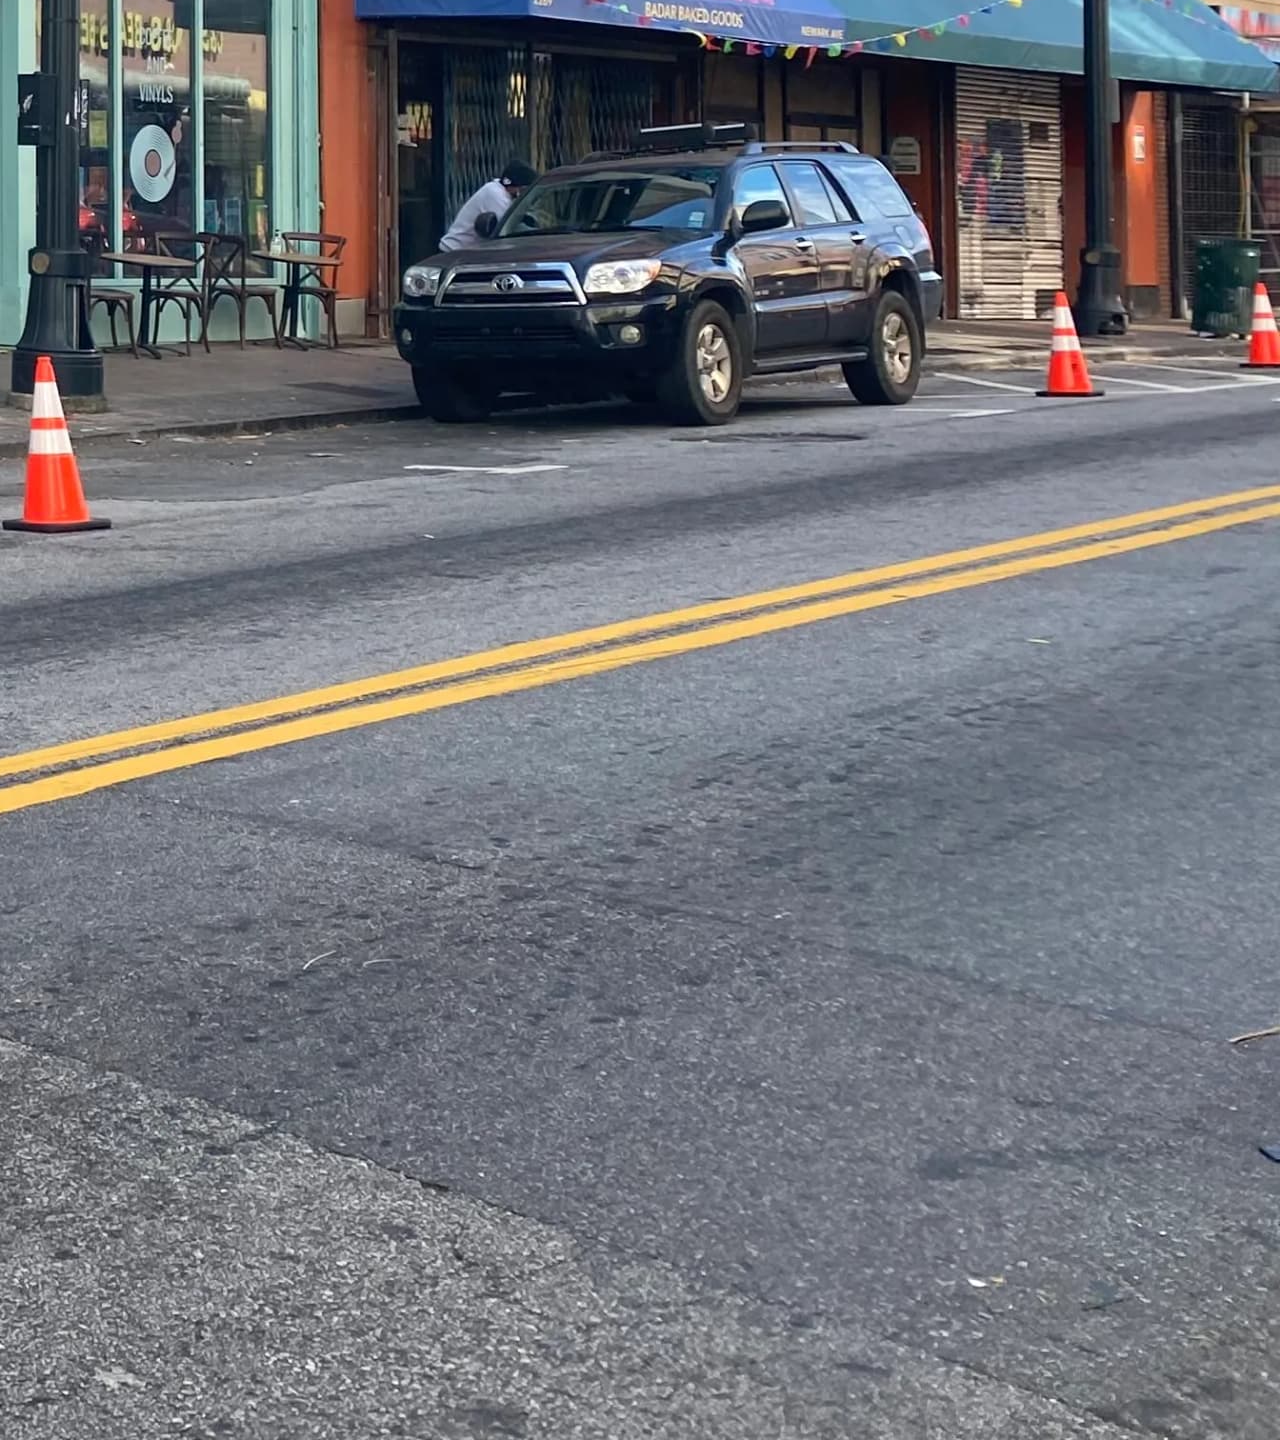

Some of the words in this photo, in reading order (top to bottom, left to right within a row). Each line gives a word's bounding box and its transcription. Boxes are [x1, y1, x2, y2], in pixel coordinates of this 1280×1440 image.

[644, 0, 678, 20] BADAR
[678, 5, 709, 24] BAKED
[710, 9, 744, 29] GOODS
[145, 55, 167, 74] AND
[139, 83, 174, 104] VINYLS
